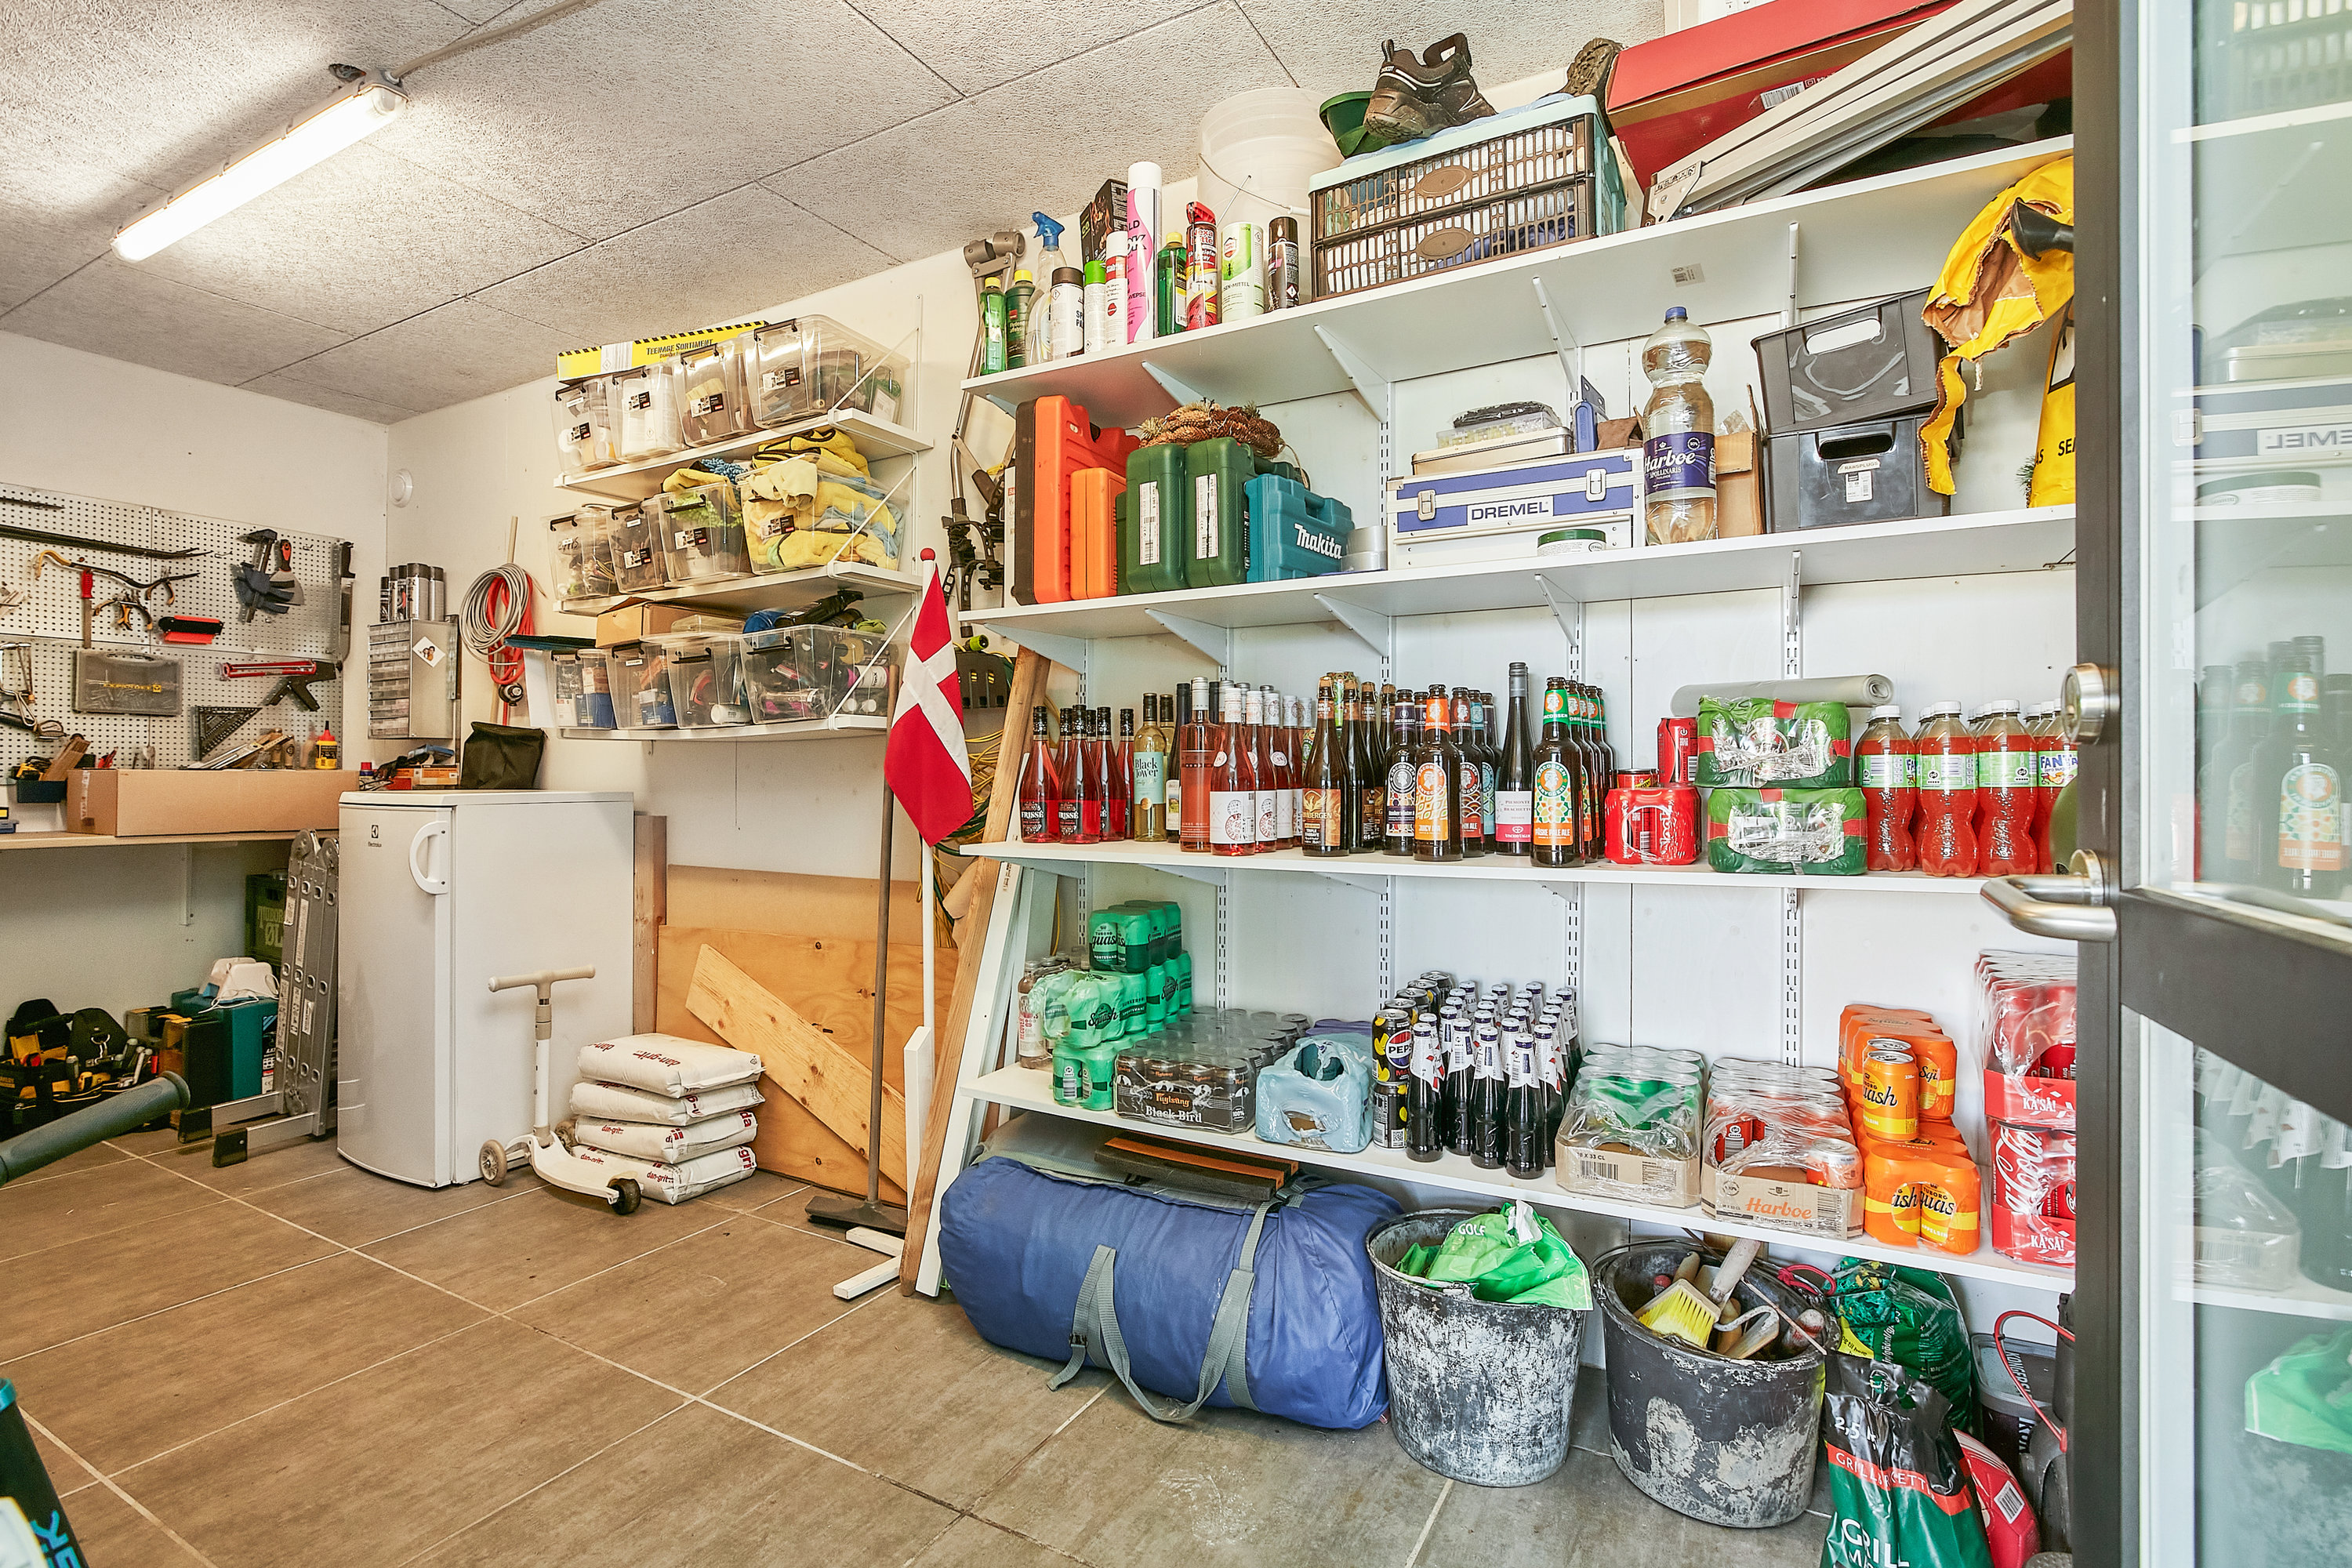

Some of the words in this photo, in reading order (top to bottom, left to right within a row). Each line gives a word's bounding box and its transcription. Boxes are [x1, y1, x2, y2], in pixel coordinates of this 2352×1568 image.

[646, 345, 674, 356] TEENAGE
[1644, 449, 1697, 474] Harboe
[1471, 501, 1549, 521] DREMEL
[1134, 757, 1157, 770] Black
[1537, 764, 1567, 777] JACOBSEN
[1136, 768, 1159, 779] Tower
[1561, 828, 1570, 837] ALE
[1087, 1007, 1119, 1029] Squash
[2023, 1097, 2056, 1112] KÅ'SÅ!
[1145, 1105, 1174, 1120] Black
[1177, 1109, 1203, 1123] Bird
[1923, 1187, 1947, 1200] TUBORG
[1745, 1197, 1813, 1220] Harboe
[1457, 1223, 1486, 1236] GOLF
[2030, 1235, 2065, 1252] KÅ'SÅ!
[1834, 1417, 1860, 1439] 2,5
